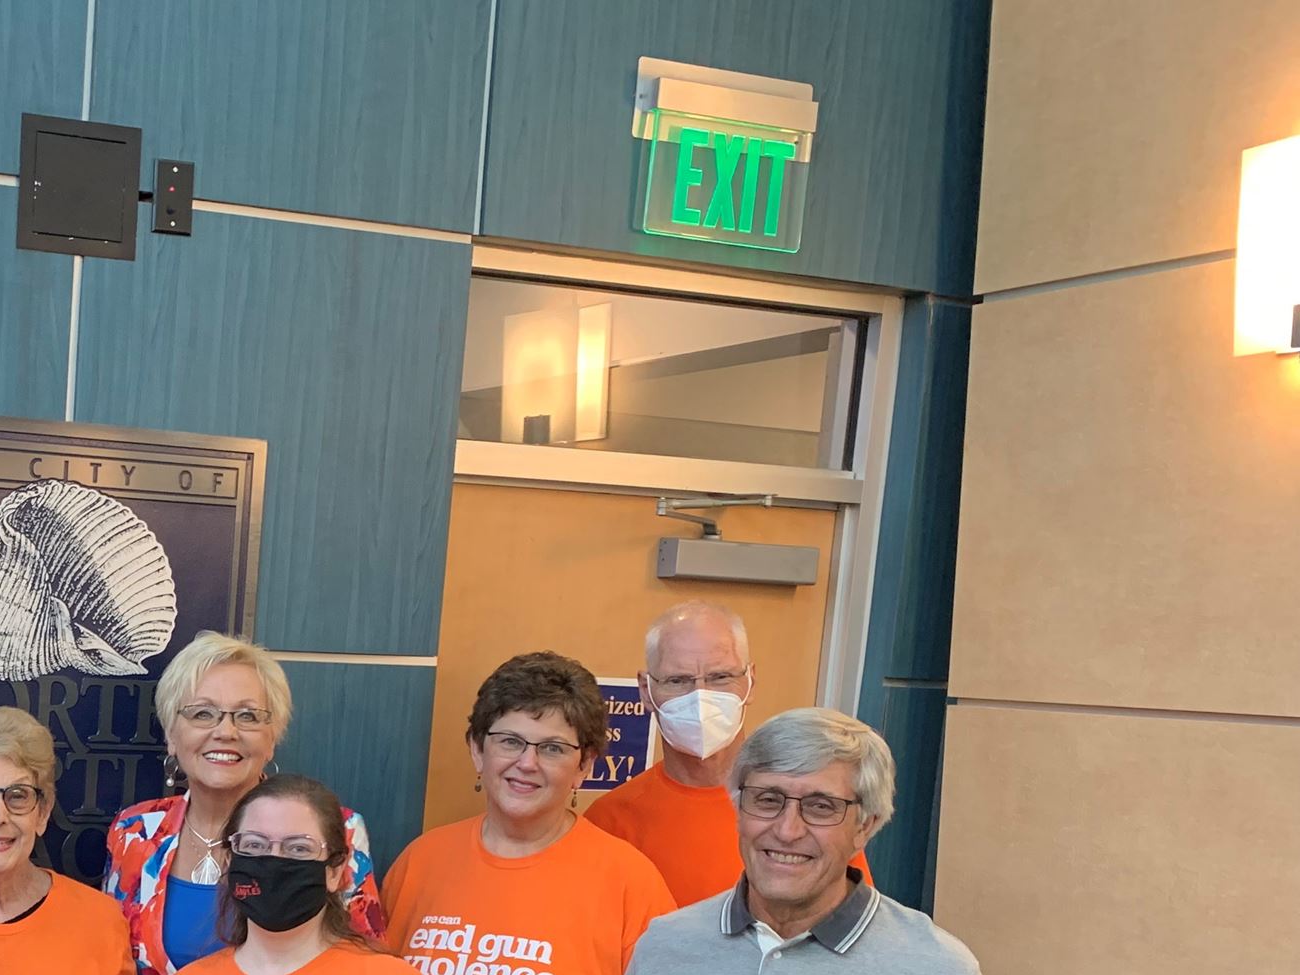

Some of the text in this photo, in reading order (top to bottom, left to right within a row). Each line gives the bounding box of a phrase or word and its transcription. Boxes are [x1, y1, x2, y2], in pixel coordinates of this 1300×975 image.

[671, 127, 796, 237] EXIT
[30, 458, 136, 486] CITY
[179, 470, 225, 492] OF
[438, 916, 461, 925] can
[409, 924, 553, 965] end gun
